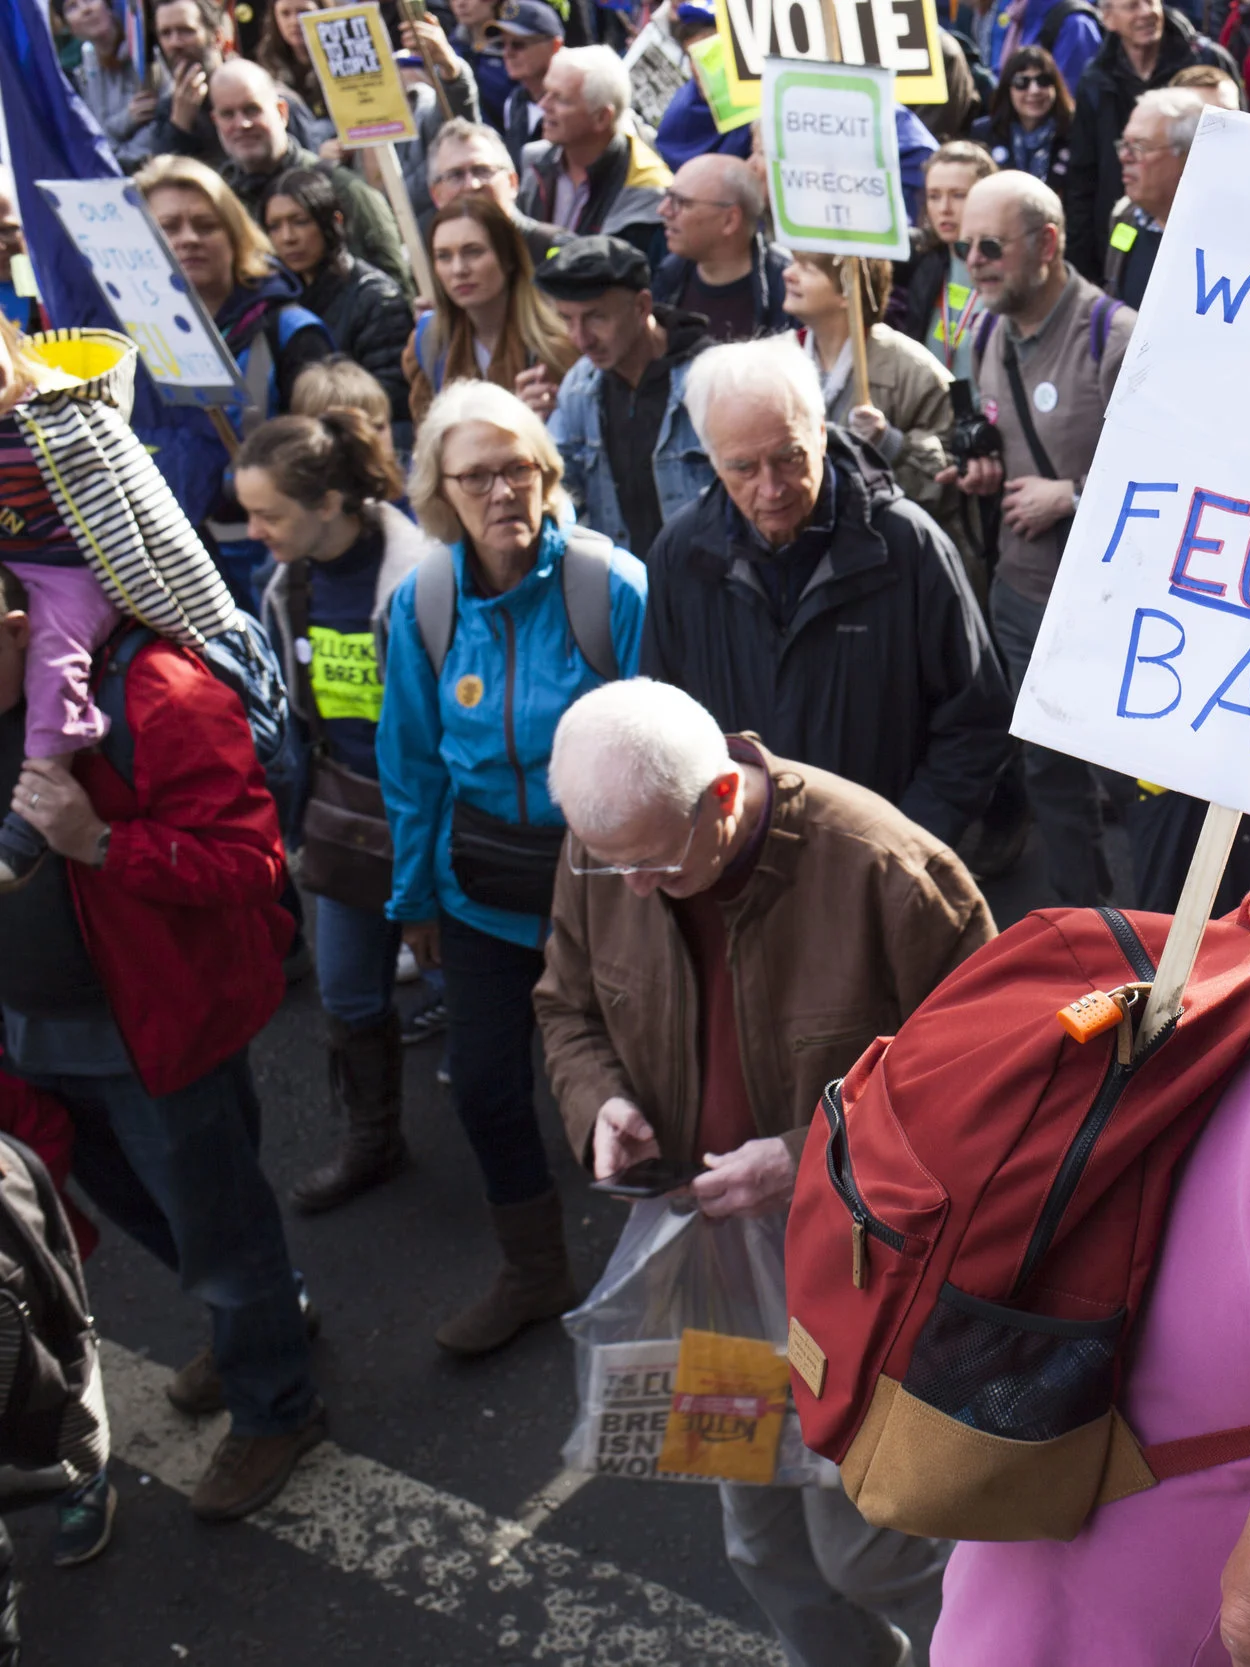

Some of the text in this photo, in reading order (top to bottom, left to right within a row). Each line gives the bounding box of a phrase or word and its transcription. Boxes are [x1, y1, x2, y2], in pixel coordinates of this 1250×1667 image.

[317, 16, 371, 44] PUT IT
[727, 0, 931, 75] VOTE
[786, 111, 869, 137] BREXIT
[781, 169, 885, 197] WRECKS
[77, 202, 123, 222] OUR
[825, 203, 852, 227] IT!
[128, 274, 160, 306] IS
[602, 1411, 670, 1432] BRE
[597, 1434, 657, 1454] ISN
